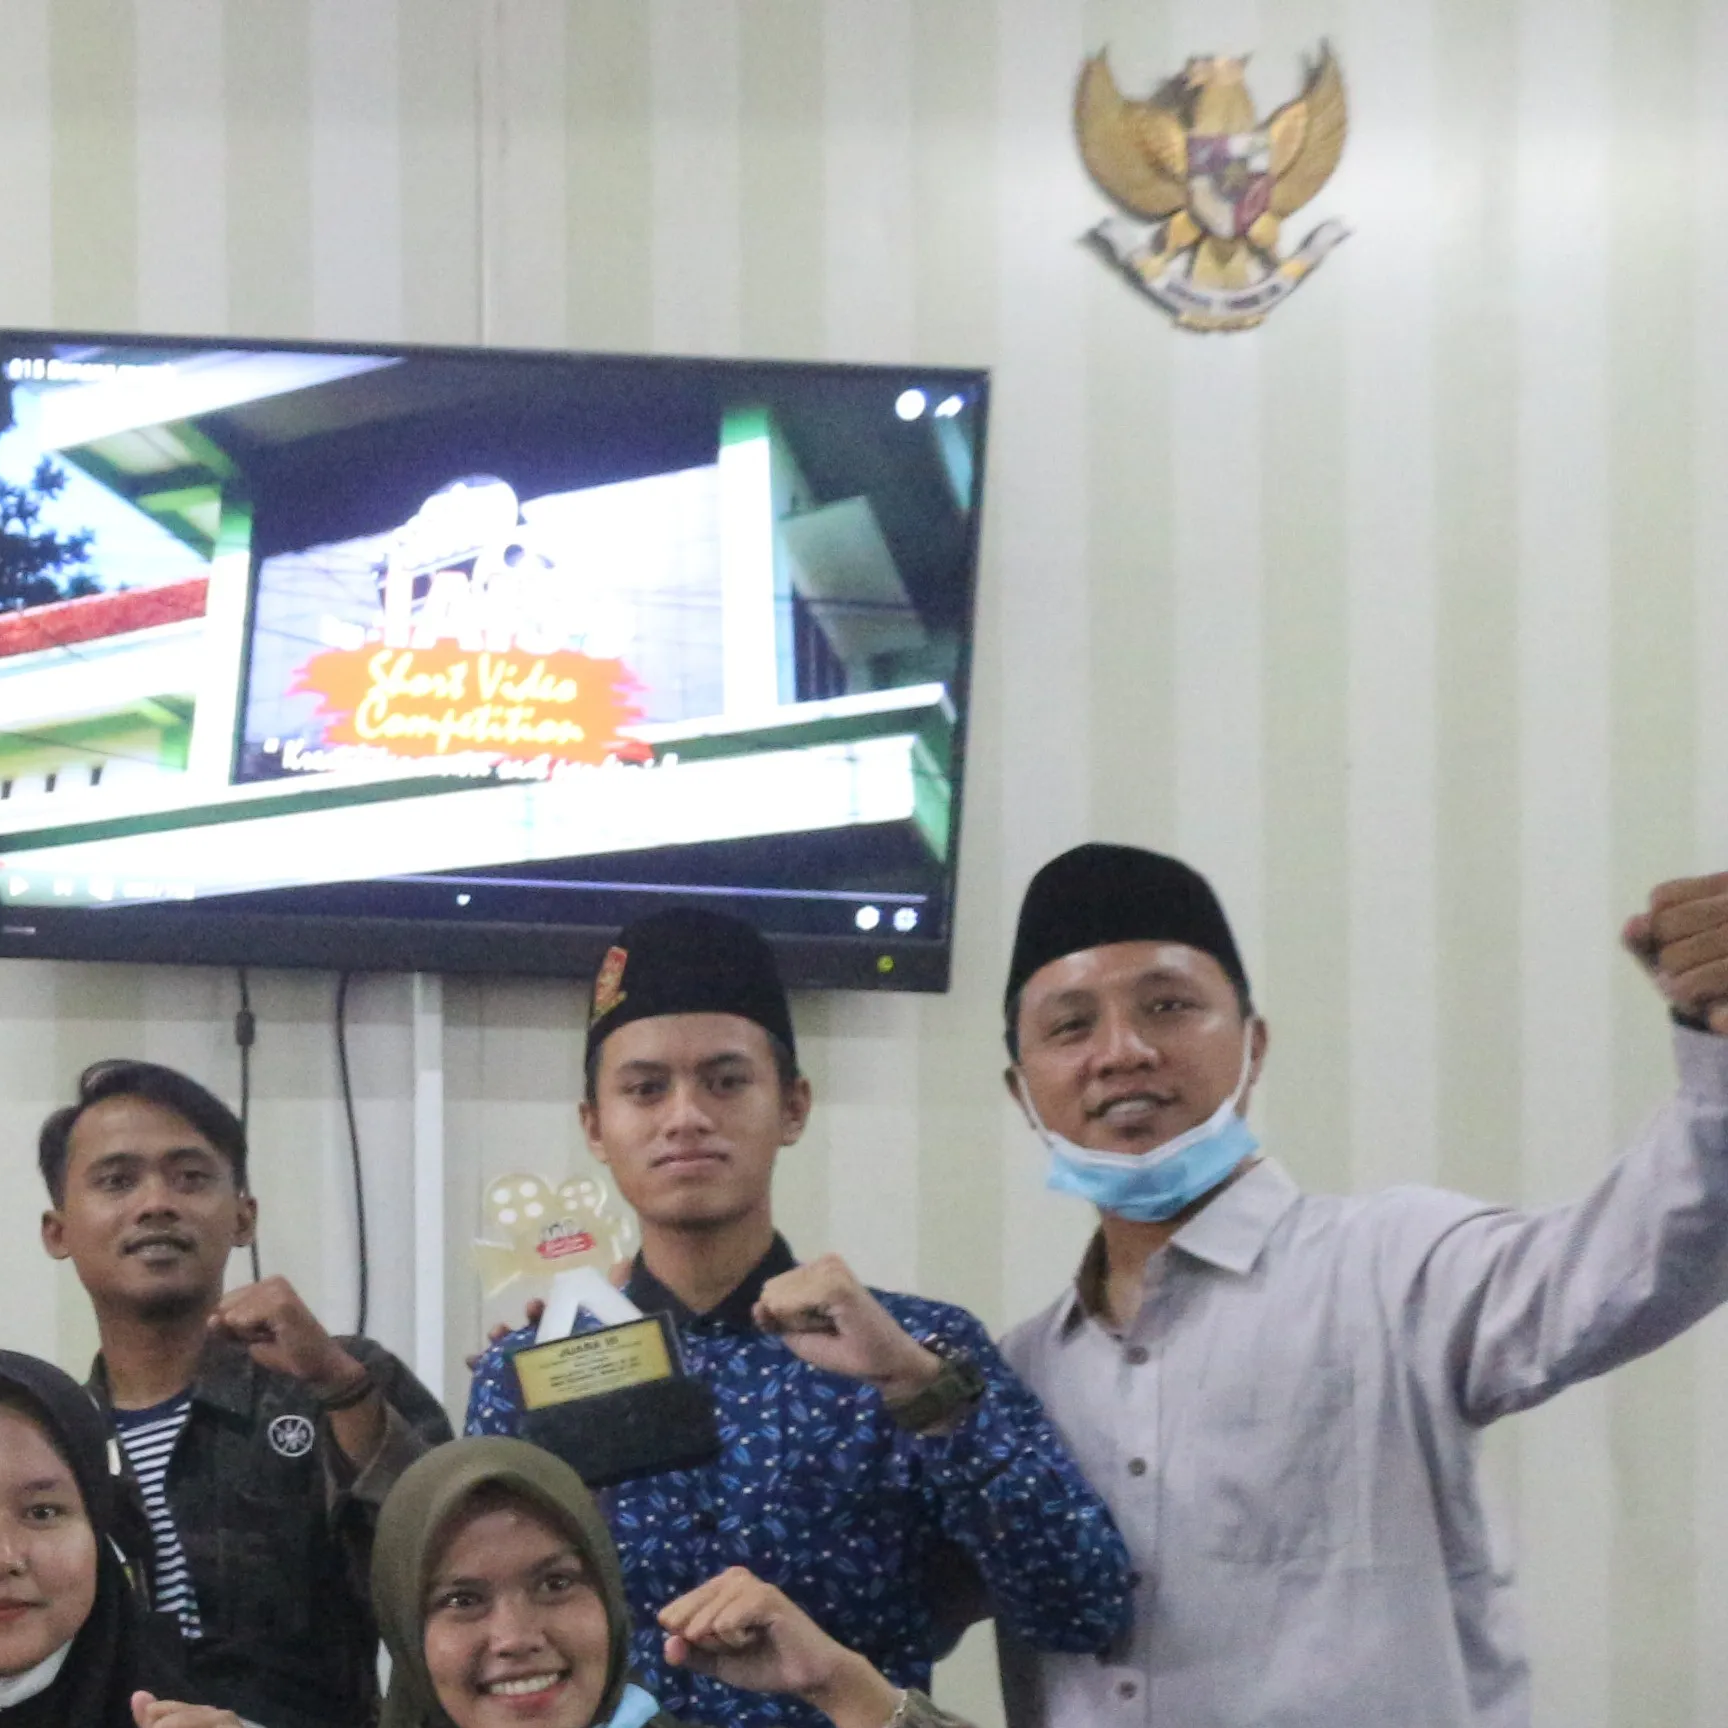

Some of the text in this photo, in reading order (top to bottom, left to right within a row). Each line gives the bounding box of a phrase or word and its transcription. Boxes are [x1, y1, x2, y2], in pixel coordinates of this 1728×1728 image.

[367, 649, 578, 704] Short Video
[355, 691, 585, 753] Competition
